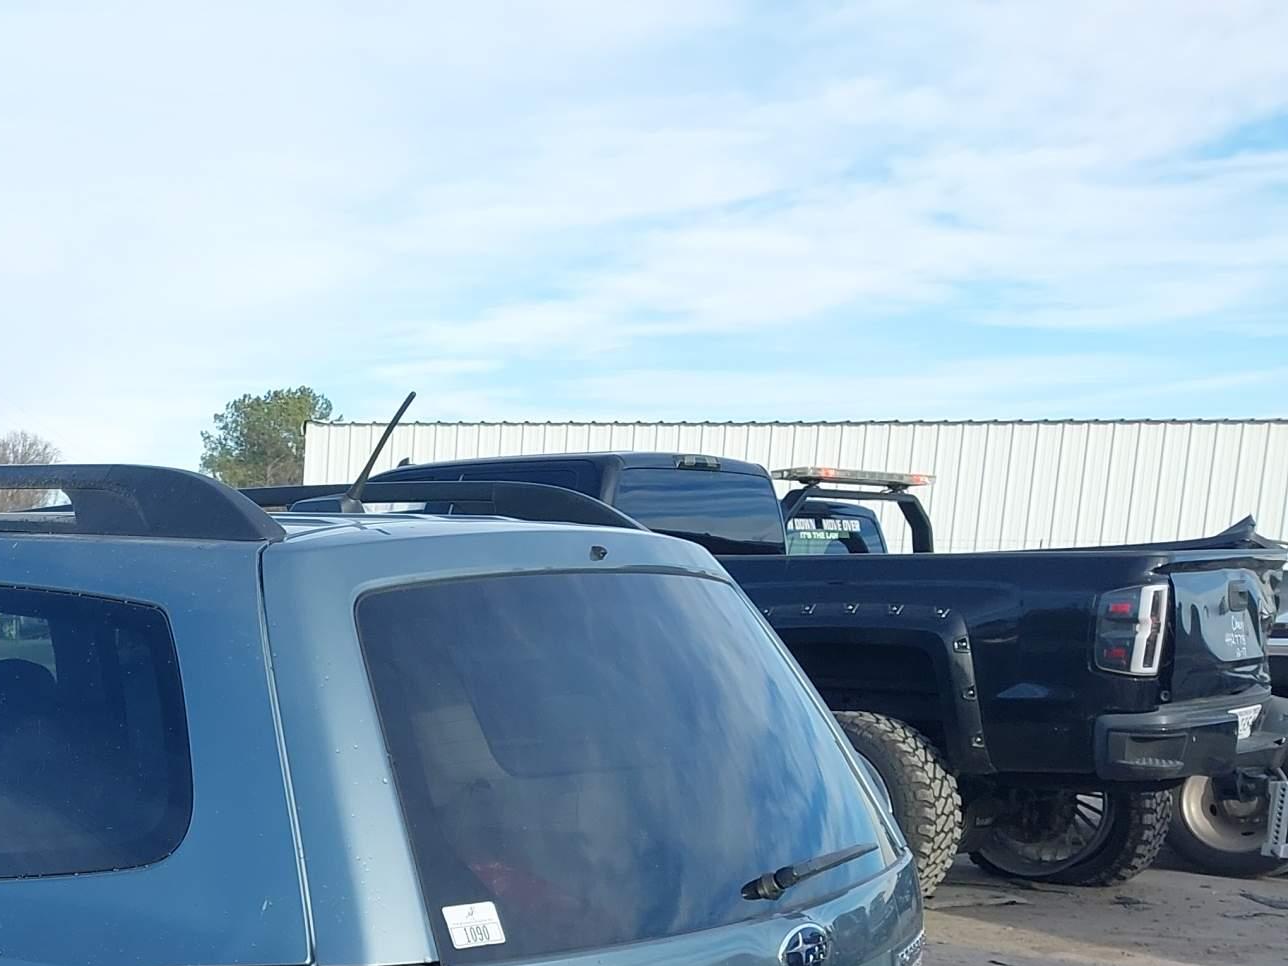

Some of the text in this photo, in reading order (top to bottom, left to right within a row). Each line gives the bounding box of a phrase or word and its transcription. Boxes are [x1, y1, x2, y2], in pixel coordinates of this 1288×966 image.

[794, 518, 816, 530] DOWN
[822, 518, 842, 531] MOVE
[842, 520, 861, 532] OVER
[464, 924, 490, 943] 1090
